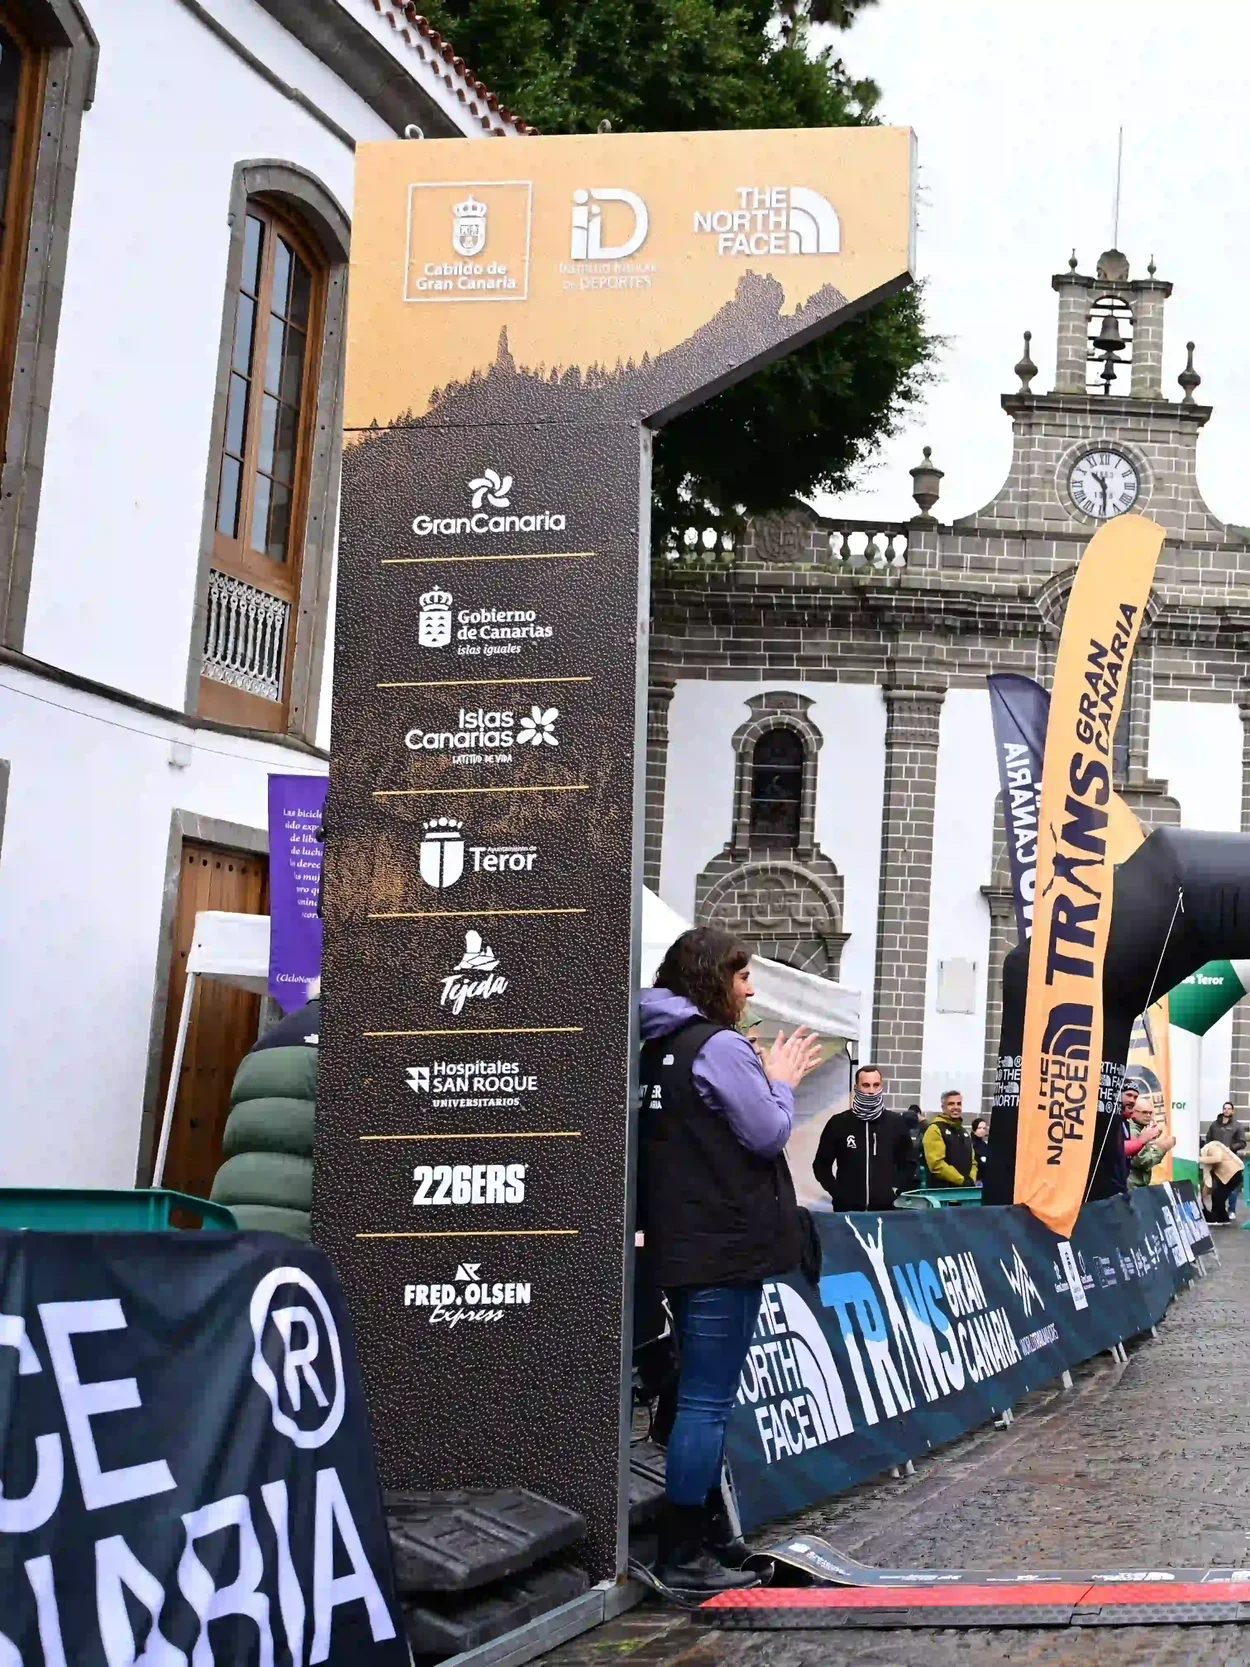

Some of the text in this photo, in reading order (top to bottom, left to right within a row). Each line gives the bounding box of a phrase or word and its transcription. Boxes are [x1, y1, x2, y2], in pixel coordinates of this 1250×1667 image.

[737, 186, 787, 208] THE
[694, 208, 788, 233] NORTH
[718, 232, 787, 255] FACE
[424, 261, 507, 275] Cabildo de
[416, 275, 517, 291] Gran Canaria
[412, 511, 566, 536] GranCanaria
[457, 609, 536, 625] Gobierno
[457, 624, 553, 641] de Canarias
[457, 643, 522, 657] islas iguales
[1076, 638, 1108, 745] GRAN
[1095, 603, 1137, 757] CANARIA
[459, 708, 514, 729] Islas
[404, 727, 514, 750] Canarias
[469, 847, 537, 872] Teror
[440, 973, 509, 1016] Tejeda
[433, 1060, 520, 1081] Hospitales
[433, 1075, 538, 1092] SAN ROQUE
[432, 1097, 520, 1108] UNIVERSITARIOS
[1047, 1059, 1066, 1165] NORTH
[1063, 1063, 1088, 1140] FACE
[412, 1163, 526, 1206] 226ERS
[404, 1282, 532, 1306] FRED. OLSEN
[937, 1251, 987, 1318] GRAN
[429, 1304, 505, 1328] Express
[753, 1283, 787, 1338] HE
[957, 1307, 1022, 1383] CANARIA
[754, 1395, 818, 1464] FACE
